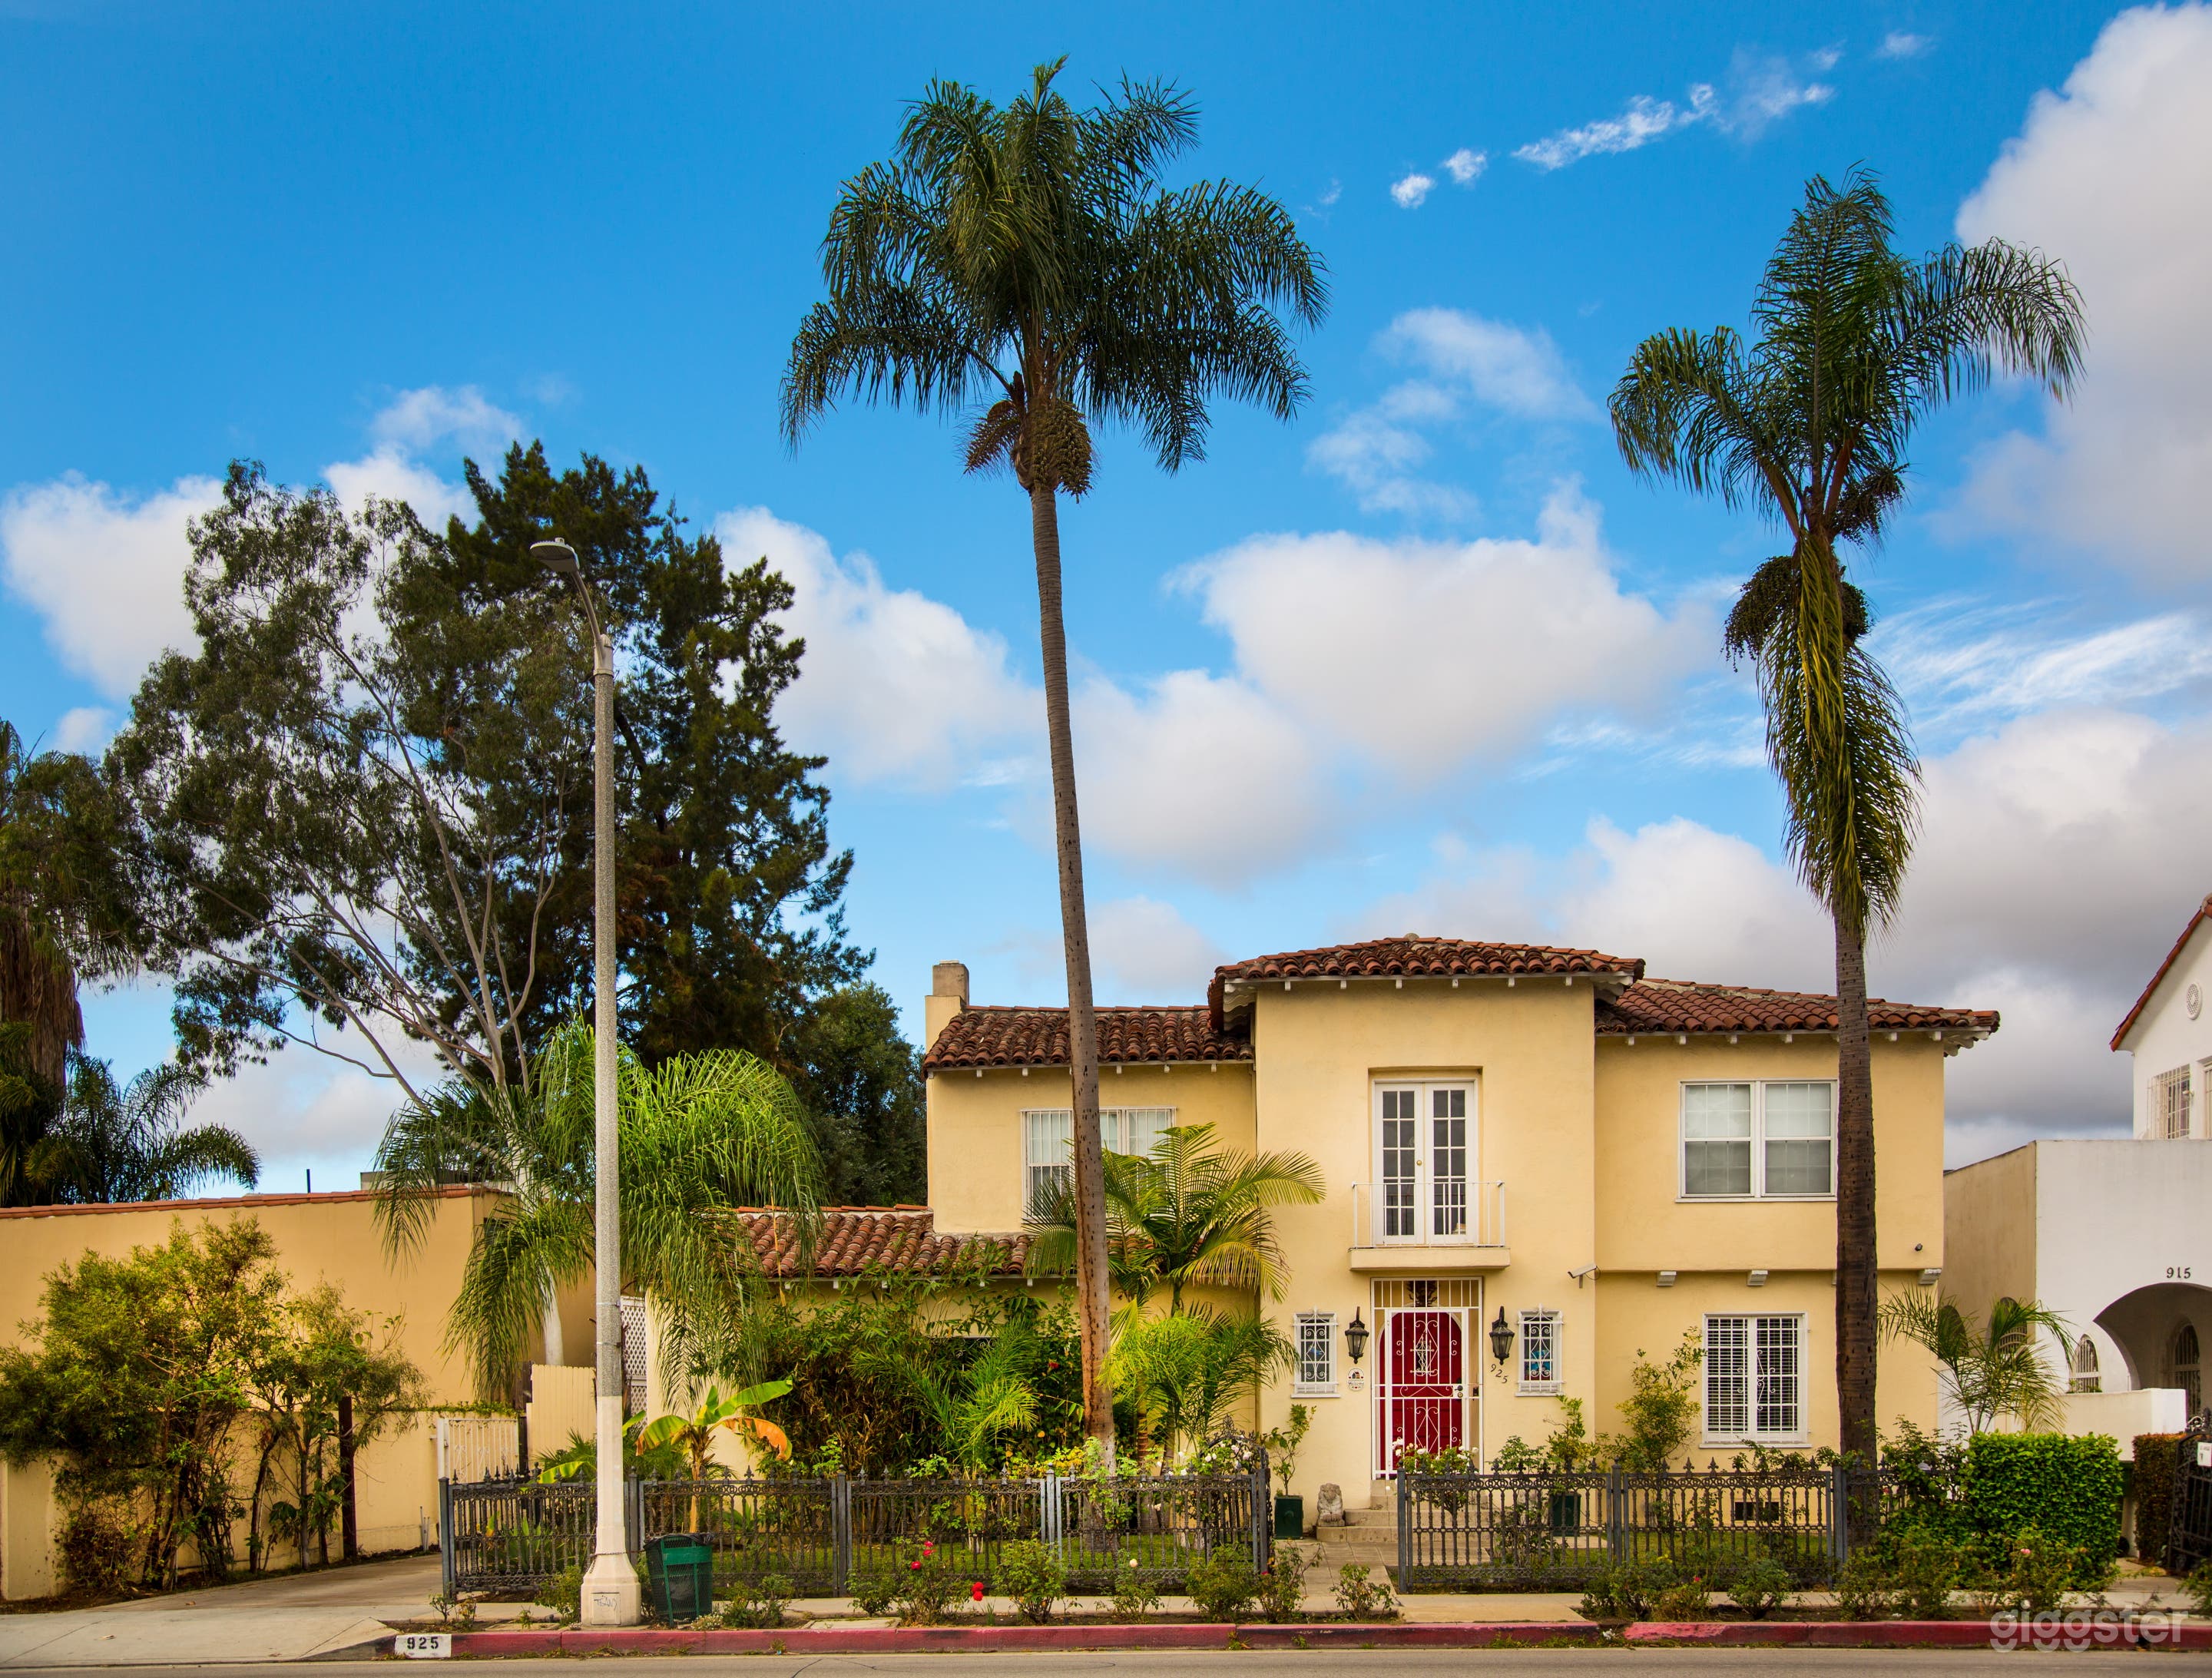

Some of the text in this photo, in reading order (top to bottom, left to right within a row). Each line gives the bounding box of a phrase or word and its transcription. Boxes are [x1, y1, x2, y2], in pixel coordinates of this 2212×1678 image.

[2166, 1266, 2191, 1279] 915
[1490, 1363, 1508, 1384] 925
[406, 1637, 439, 1650] 925
